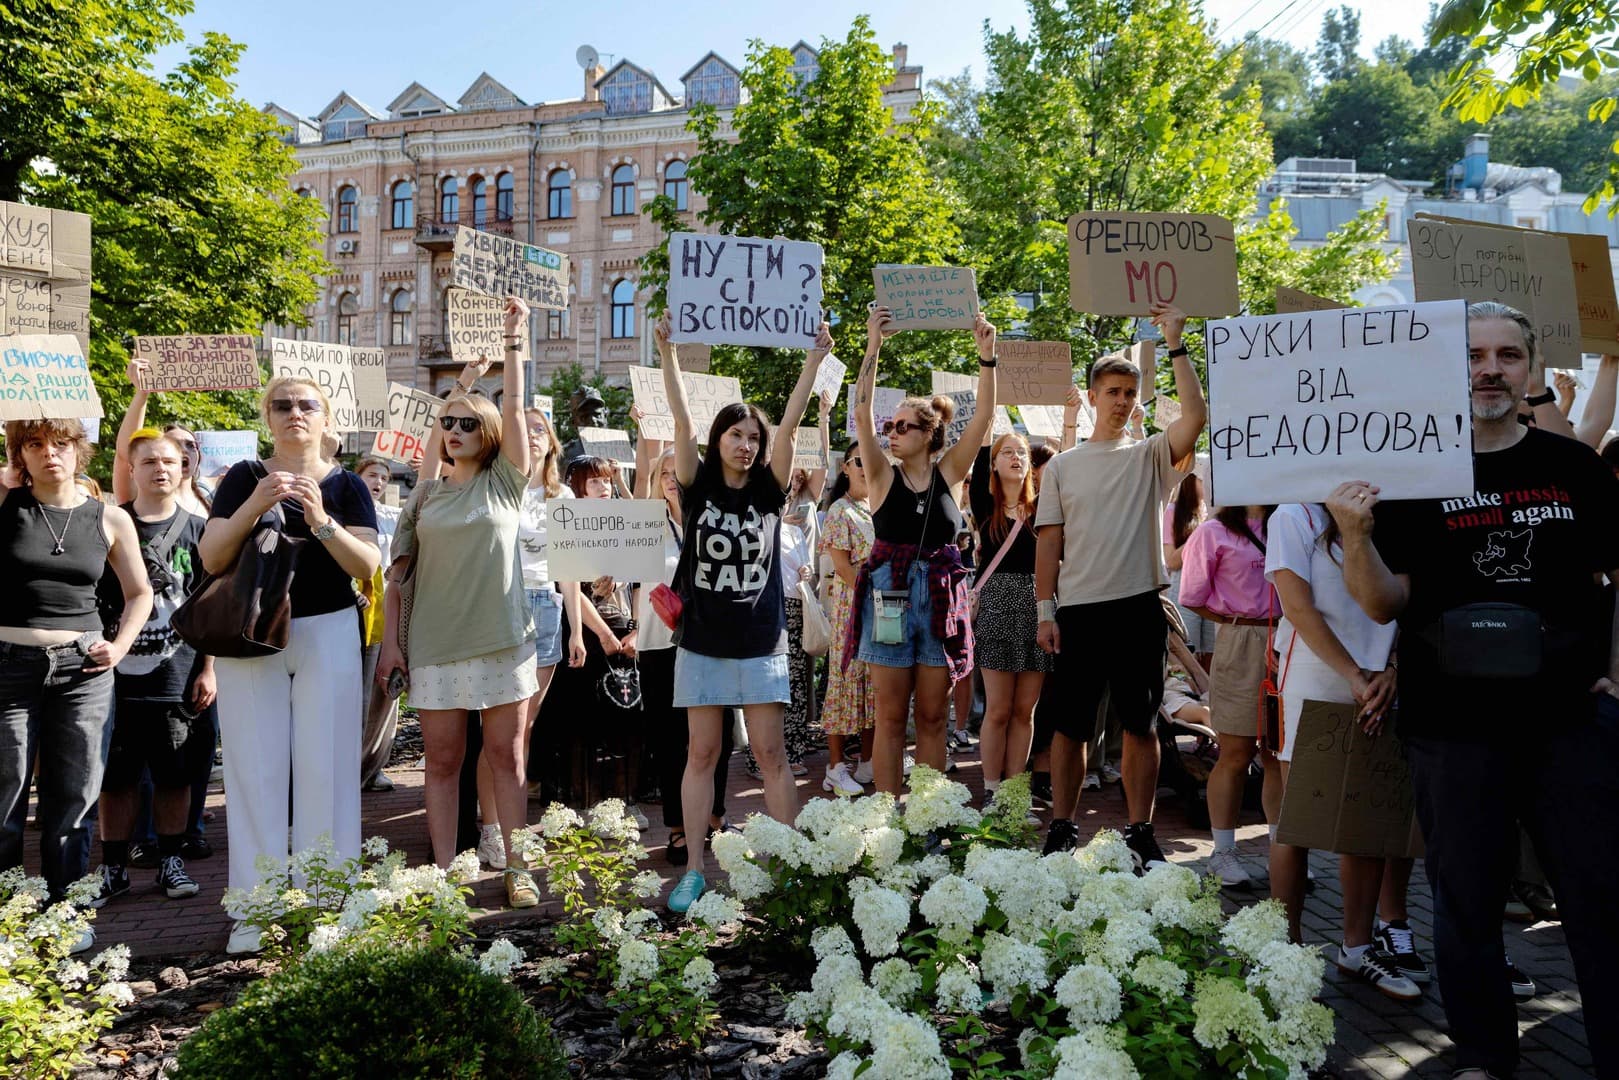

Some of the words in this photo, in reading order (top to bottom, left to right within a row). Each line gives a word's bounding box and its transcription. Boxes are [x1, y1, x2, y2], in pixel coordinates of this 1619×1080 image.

[464, 230, 523, 259] ХВОРЕ
[1075, 218, 1213, 254] ФЕДОРОВ
[1417, 225, 1464, 260] ЗСУ
[455, 253, 560, 291] ДЕРЖАВНА
[681, 239, 726, 278] НУ
[736, 242, 785, 280] ТИ
[720, 278, 755, 304] СІ
[798, 263, 816, 303] ?
[882, 269, 960, 288] МІНЯЙТЕ
[1125, 260, 1177, 304] МО
[451, 293, 504, 310] КОНЧЕН
[139, 339, 152, 352] В
[154, 337, 182, 350] НАС
[187, 337, 206, 350] ЗА
[209, 336, 253, 350] ЗМІНИ
[1211, 318, 1313, 364] РУКИ
[1341, 309, 1430, 348] ГЕТЬ
[143, 364, 154, 376] А
[157, 364, 176, 377] ЗА
[158, 350, 250, 363] ЗВІЛЬНЯЮТЬ
[328, 349, 343, 364] ПО
[346, 350, 384, 367] НОВОЙ
[145, 375, 260, 389] НАГОРОДЖУЮТЬ
[637, 372, 664, 393] НЕ
[1297, 367, 1354, 403] ВІД
[1212, 411, 1463, 460] ФЕДОРОВА!
[1441, 491, 1503, 513] make
[1503, 485, 1571, 504] russia
[1445, 508, 1505, 531] small
[1511, 501, 1575, 526] again
[552, 537, 619, 550] УКРАЇНСЬКОГО
[625, 534, 664, 548] НАРОДУ!
